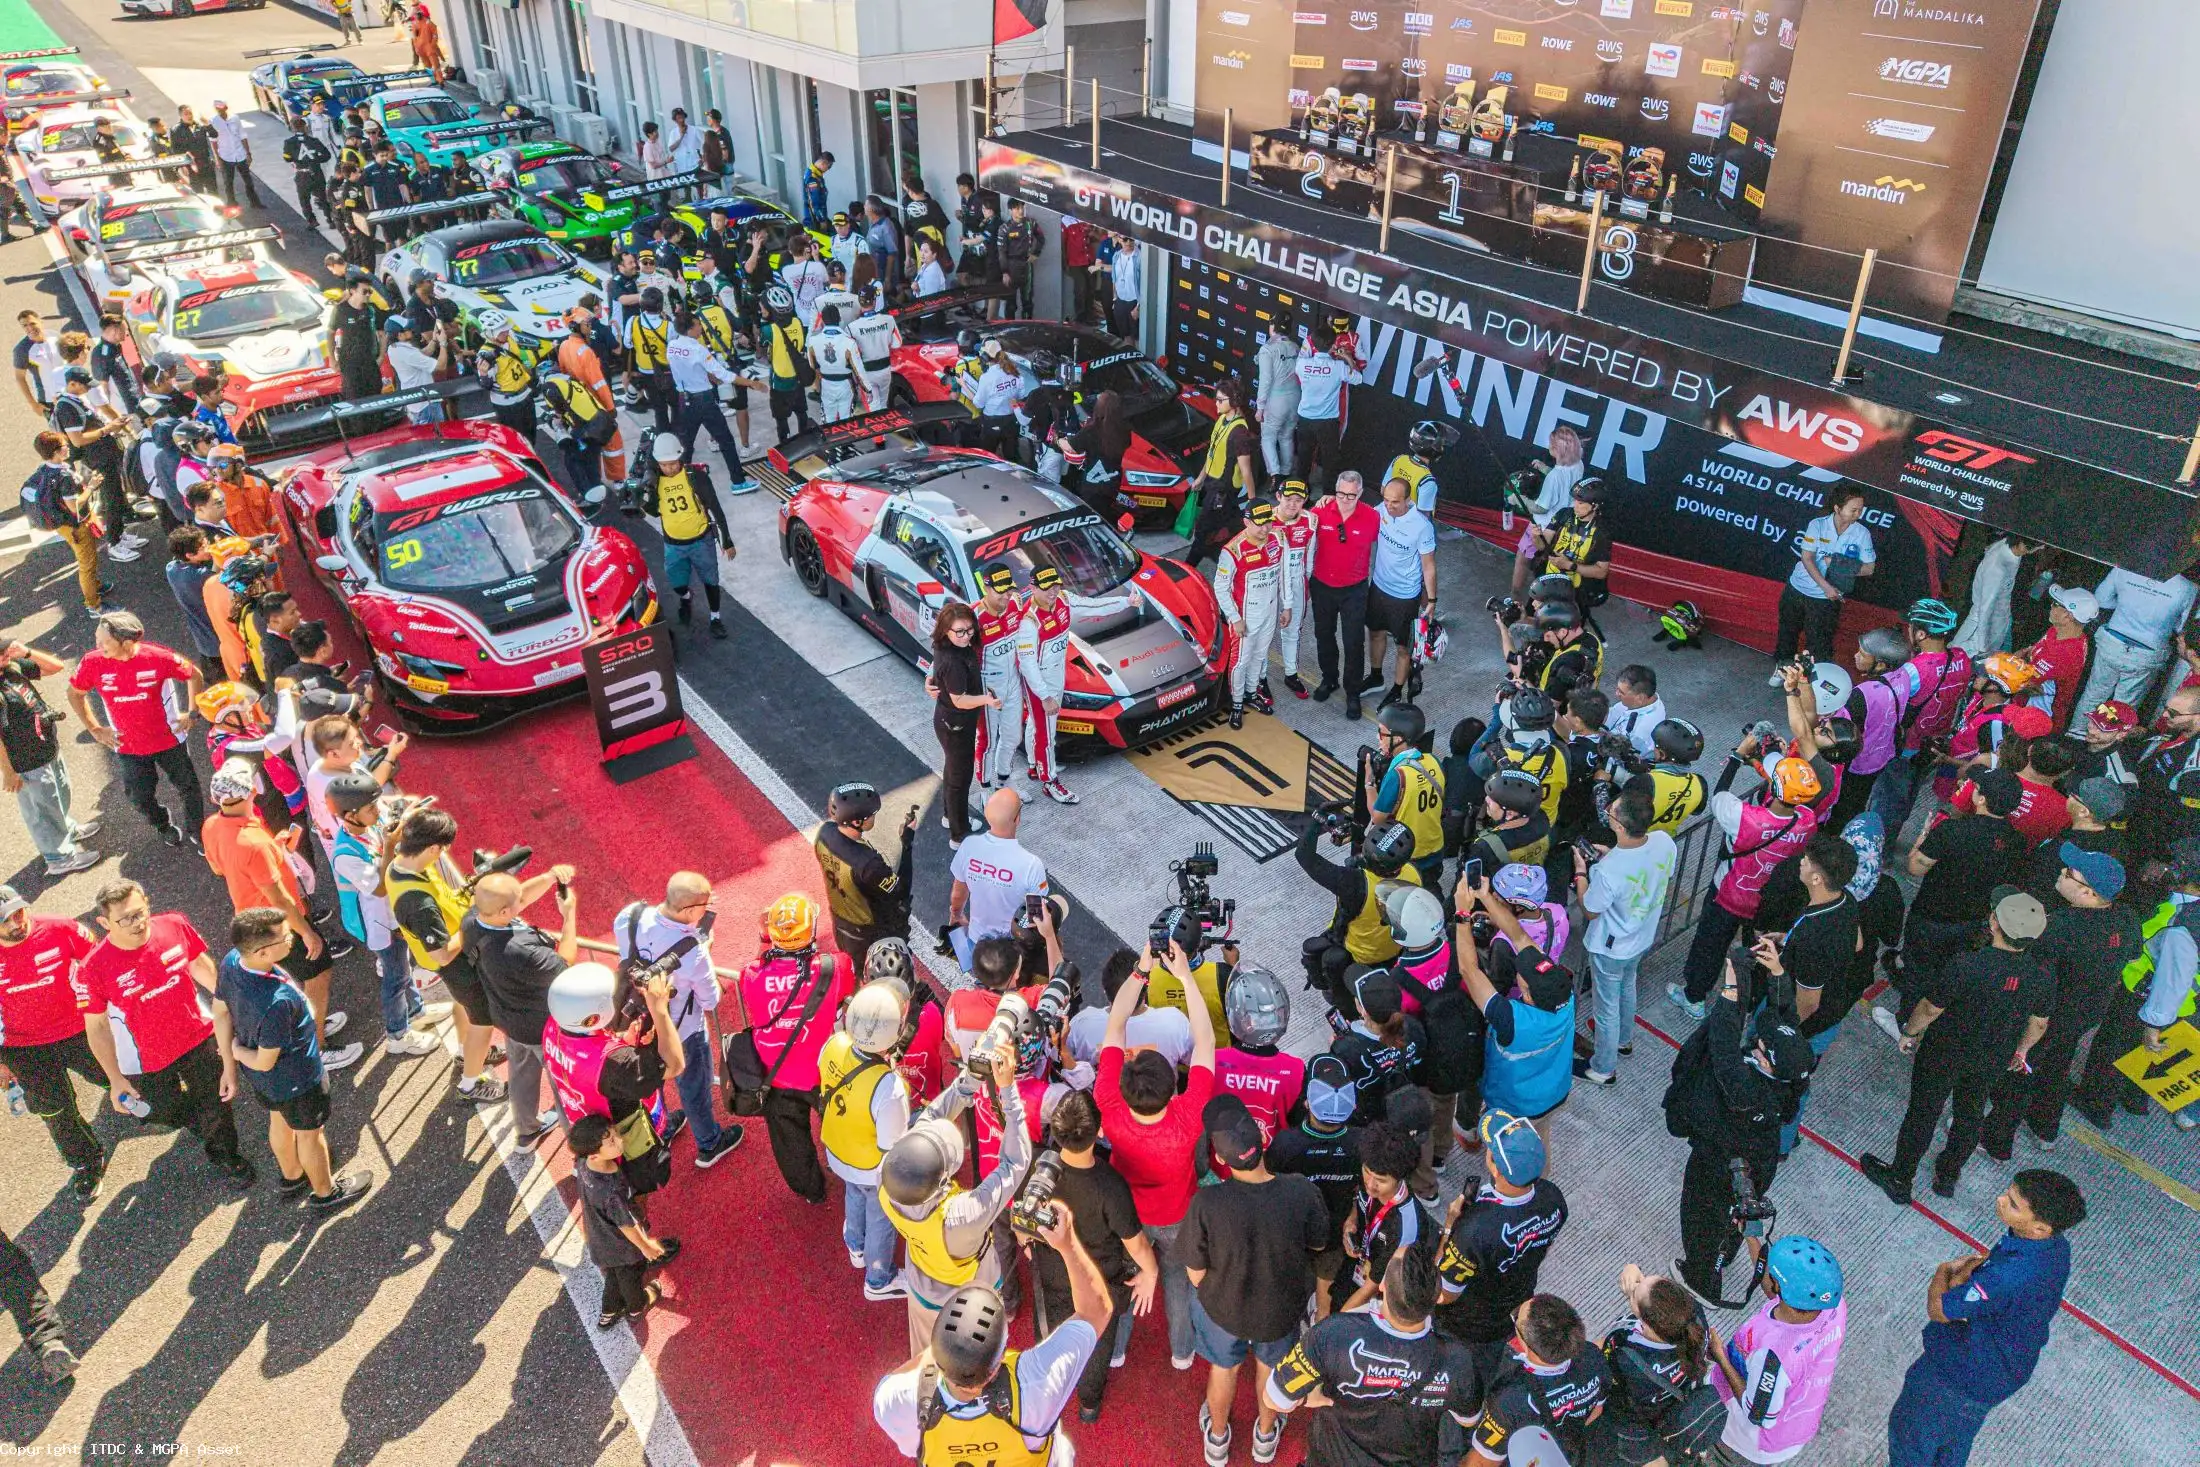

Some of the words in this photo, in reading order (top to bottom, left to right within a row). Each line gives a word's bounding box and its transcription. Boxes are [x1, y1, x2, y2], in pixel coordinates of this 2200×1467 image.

[1350, 10, 1378, 23] aws
[1903, 8, 1985, 25] MANDALIKA
[1541, 36, 1574, 51] ROWE
[1597, 39, 1624, 54] aws
[1402, 57, 1427, 70] aws
[1880, 57, 1952, 85] MGPA
[1584, 92, 1618, 108] ROWE
[1641, 96, 1669, 112] aws
[1689, 152, 1715, 169] aws
[1300, 151, 1325, 200] 2
[1438, 173, 1465, 226] 1
[1840, 179, 1905, 205] mandiri
[490, 237, 551, 251] WORLD
[1601, 225, 1637, 280] 3
[175, 310, 201, 330] 27
[1074, 186, 1105, 210] GT
[1109, 198, 1198, 242] WORLD
[1203, 223, 1382, 301] CHALLENGE
[1387, 283, 1473, 332] ASIA
[1482, 309, 1662, 389] POWERED
[1671, 369, 1733, 409] BY
[1737, 393, 1865, 454] AWS
[1090, 350, 1145, 370] WORLD
[1304, 365, 1332, 375] SRO
[1915, 430, 2039, 470] GT
[1701, 458, 1772, 496] WORLD
[1903, 462, 1928, 475] ASIA
[1914, 455, 1952, 475] WORLD
[1951, 466, 2012, 492] CHALLENGE
[664, 484, 685, 494] SRO
[1682, 472, 1726, 496] ASIA
[1899, 473, 1943, 495] powered
[1943, 486, 1958, 499] by
[1960, 491, 1985, 506] aws
[387, 503, 448, 532] GT
[441, 488, 542, 516] WORLD
[667, 494, 689, 514] 33
[1675, 495, 1758, 532] powered
[1761, 527, 1788, 546] by
[974, 527, 1032, 560] GT
[1021, 514, 1102, 542] WORLD
[386, 539, 424, 570] 50
[599, 636, 653, 664] SRO
[1132, 649, 1155, 664] Audi
[603, 670, 667, 730] 3
[1139, 697, 1208, 735] PHANTOM
[1418, 787, 1438, 813] 06
[968, 858, 1013, 883] SRO
[1225, 1073, 1281, 1096] EVENT
[2157, 1079, 2191, 1102] PARC
[947, 1441, 999, 1455] SRO
